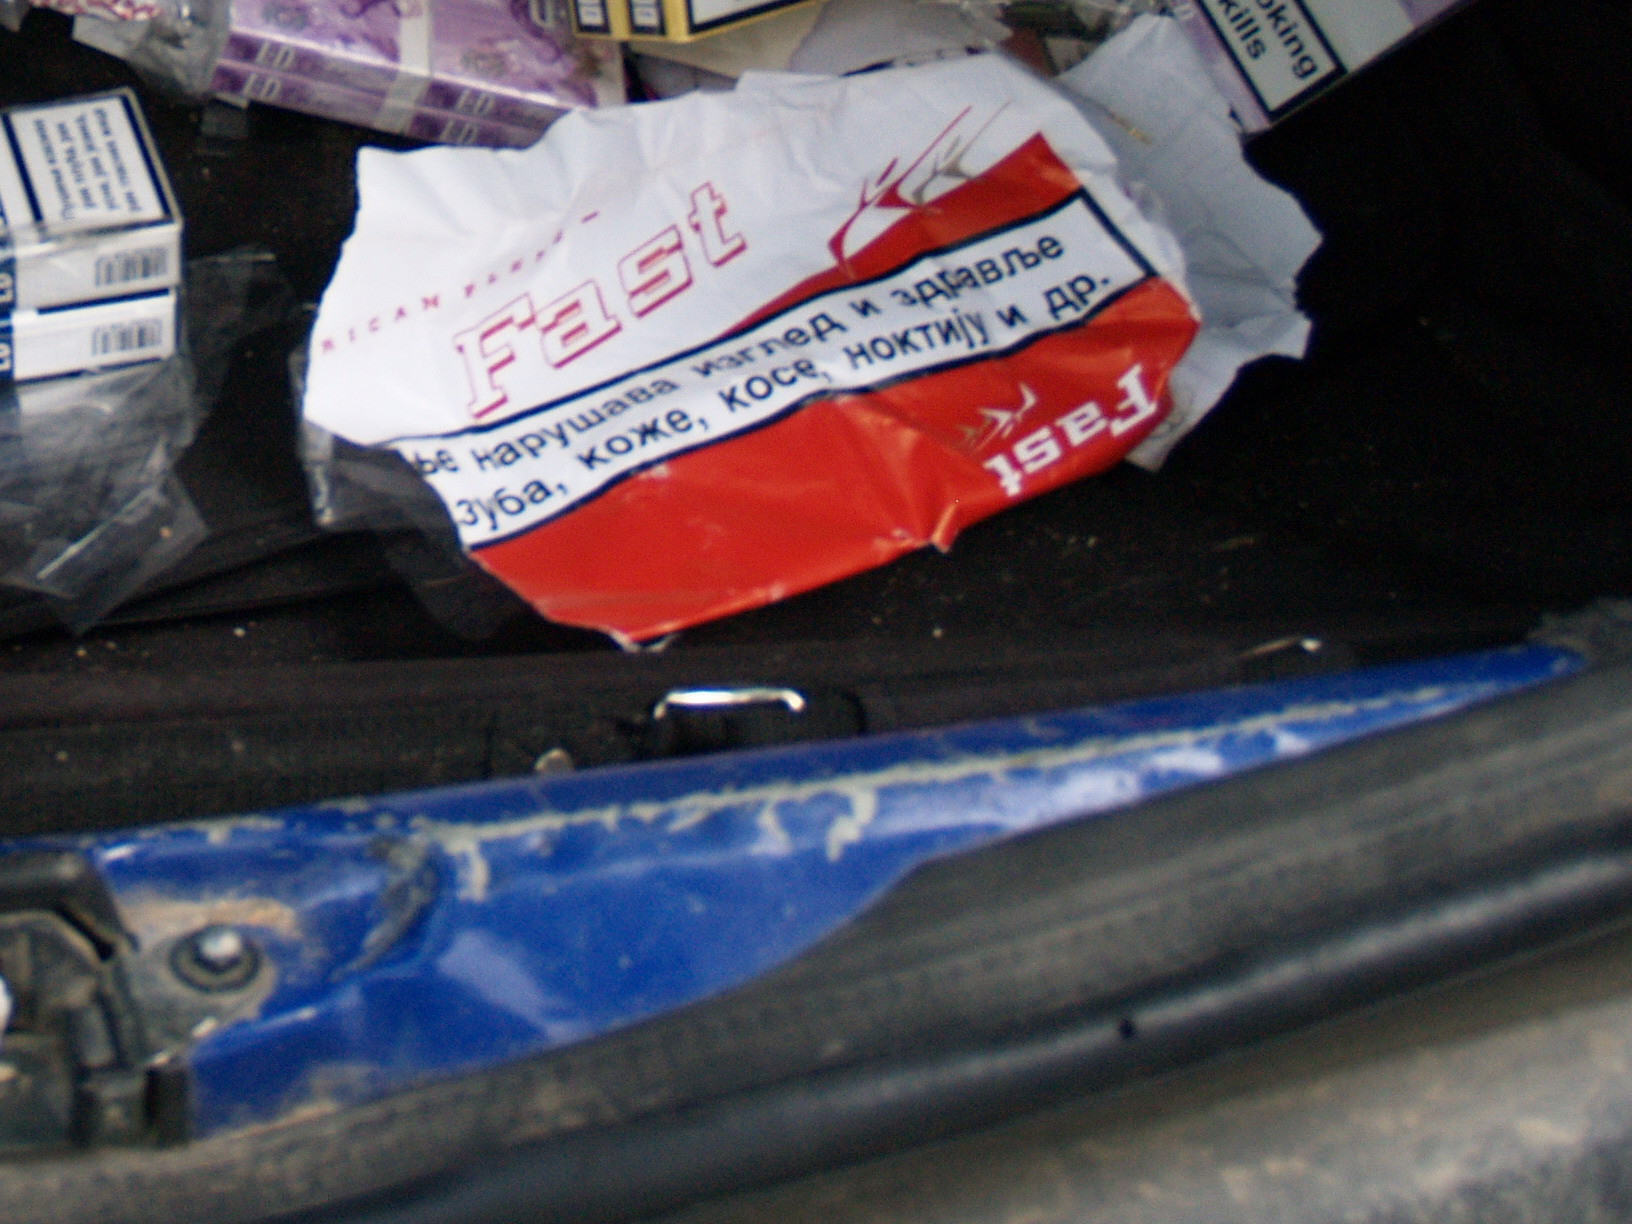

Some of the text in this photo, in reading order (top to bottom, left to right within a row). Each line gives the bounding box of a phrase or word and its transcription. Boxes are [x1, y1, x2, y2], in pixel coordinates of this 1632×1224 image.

[452, 180, 748, 420] Fast
[470, 234, 1066, 474] нарушава изглед и здравље
[576, 407, 710, 472] коже,
[717, 358, 833, 414] косе,
[997, 305, 1028, 328] и
[1044, 274, 1112, 320] др.
[983, 363, 1160, 498] Fast
